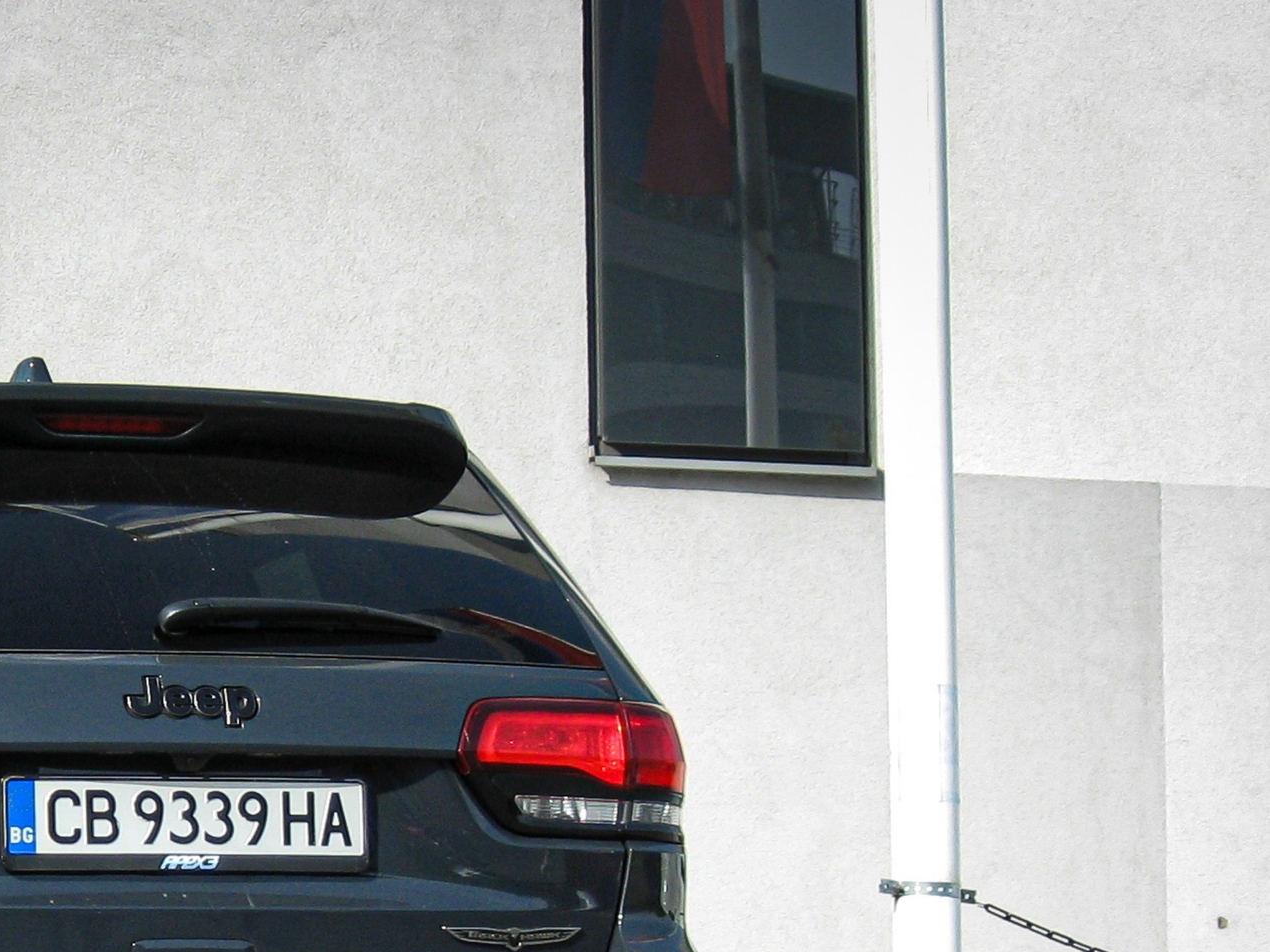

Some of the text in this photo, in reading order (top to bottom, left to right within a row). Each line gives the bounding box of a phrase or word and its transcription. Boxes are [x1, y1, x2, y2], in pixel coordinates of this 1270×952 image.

[123, 675, 262, 728] Jeep
[9, 827, 34, 844] BG
[46, 789, 353, 848] CB 9339 HA
